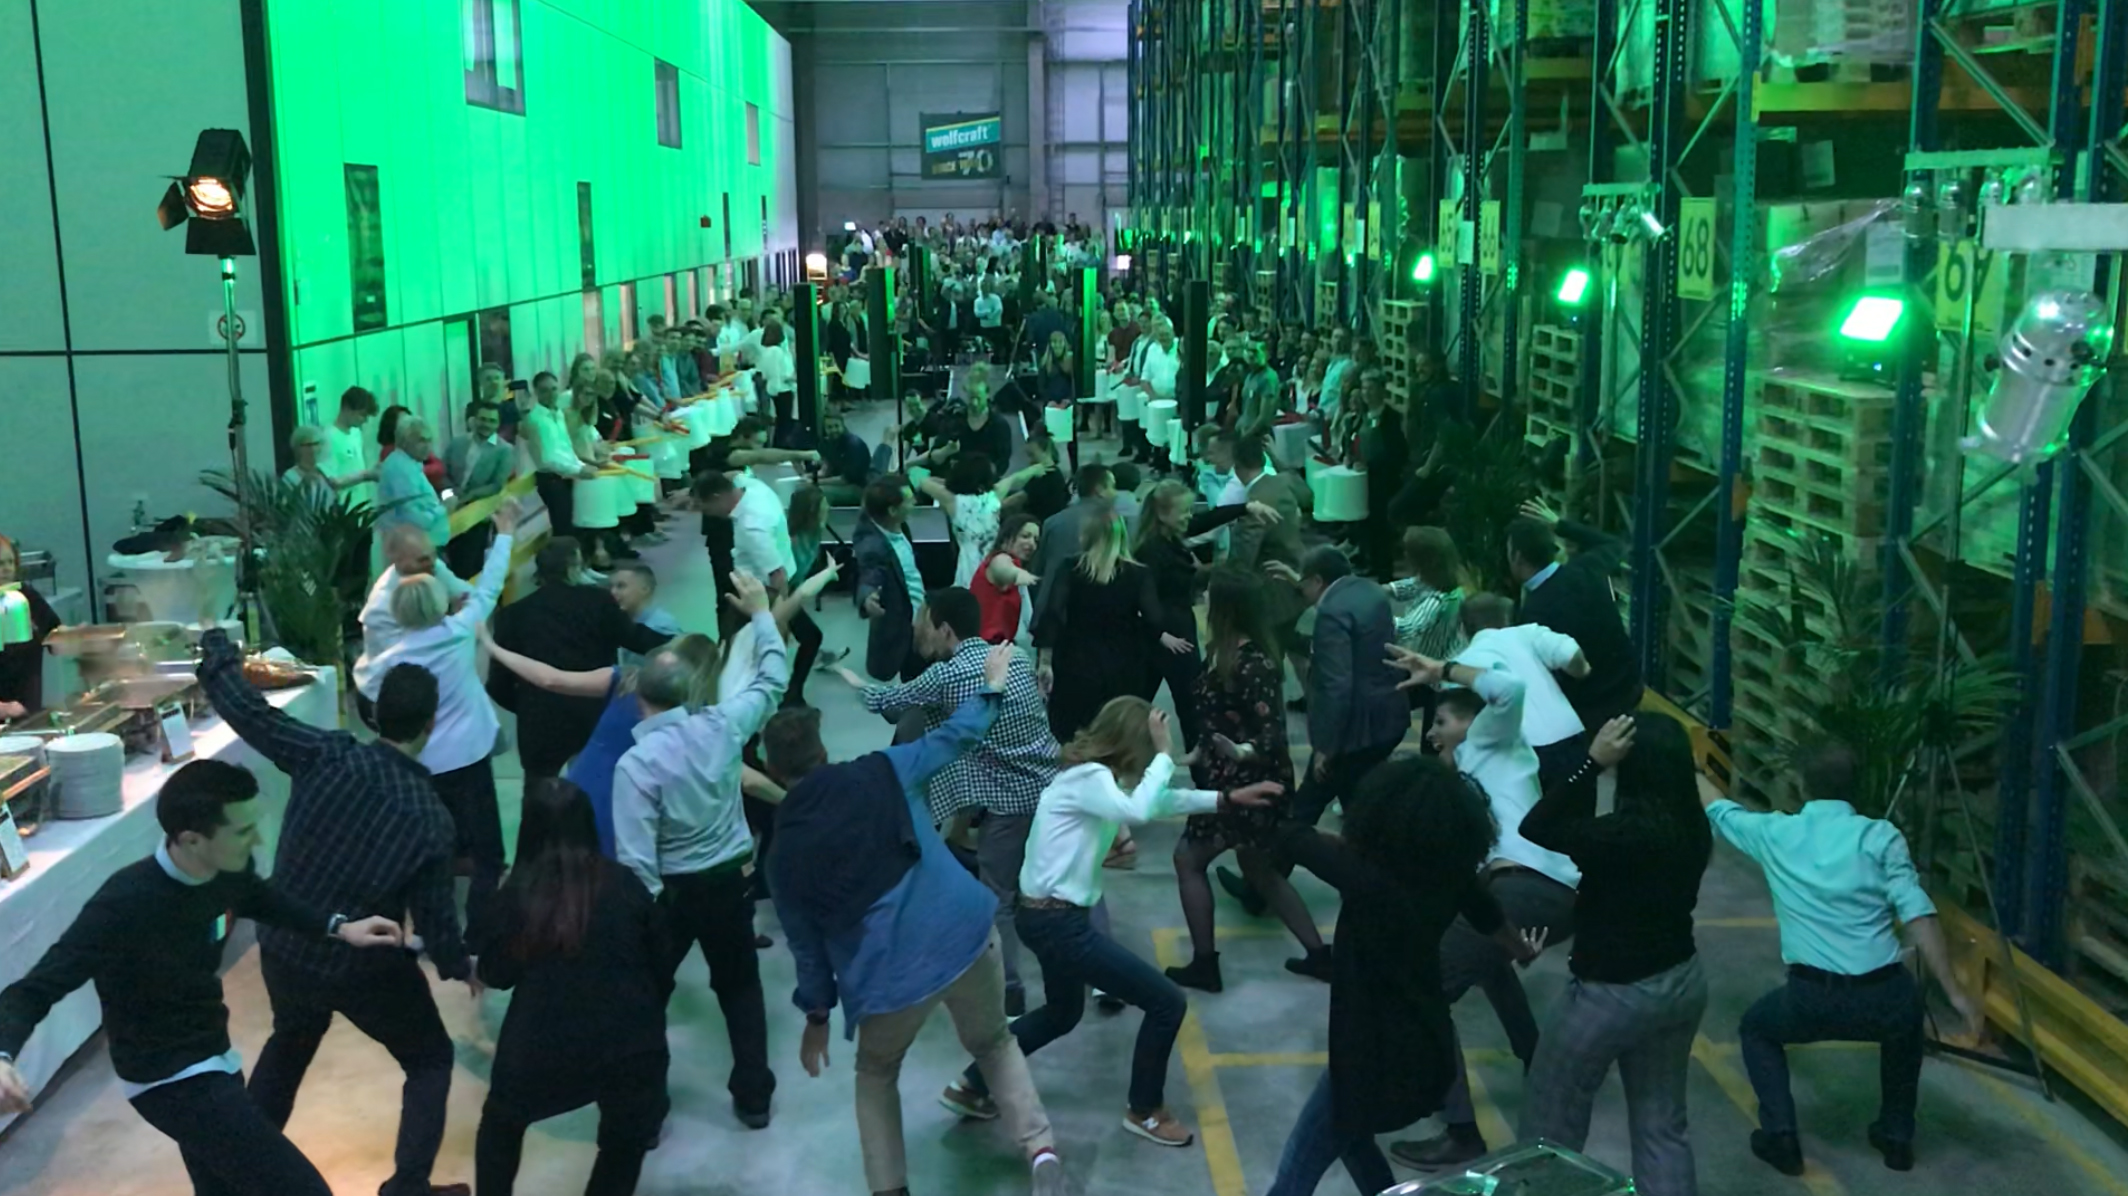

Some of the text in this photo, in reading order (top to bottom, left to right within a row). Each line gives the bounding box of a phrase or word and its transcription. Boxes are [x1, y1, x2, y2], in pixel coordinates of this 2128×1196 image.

[931, 125, 988, 148] wolfcraft
[958, 149, 993, 175] 70
[1682, 217, 1709, 278] 68
